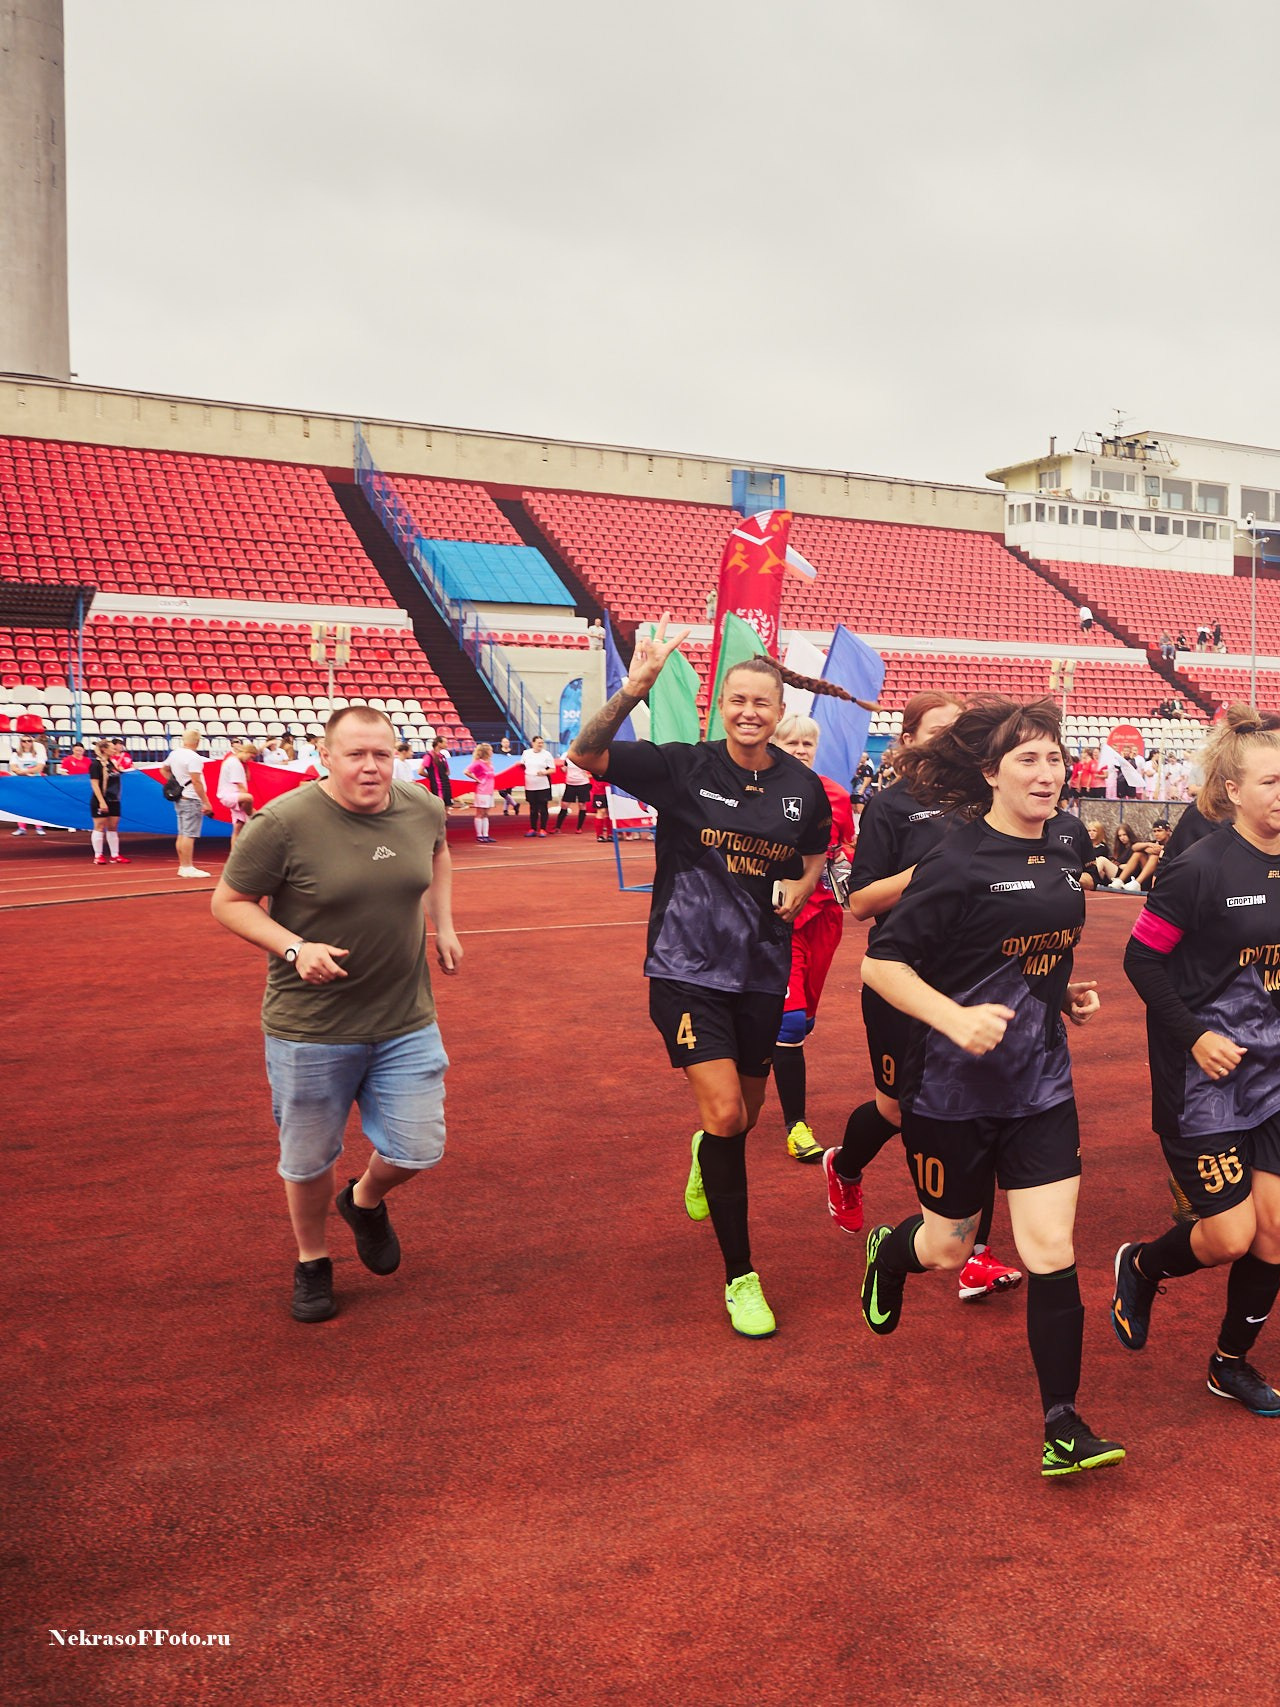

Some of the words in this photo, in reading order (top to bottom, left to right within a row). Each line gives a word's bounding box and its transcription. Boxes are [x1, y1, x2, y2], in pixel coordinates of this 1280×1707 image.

[677, 1012, 697, 1050] 4
[882, 1054, 896, 1087] 9
[913, 1153, 945, 1199] 10
[1197, 1146, 1245, 1194] 96
